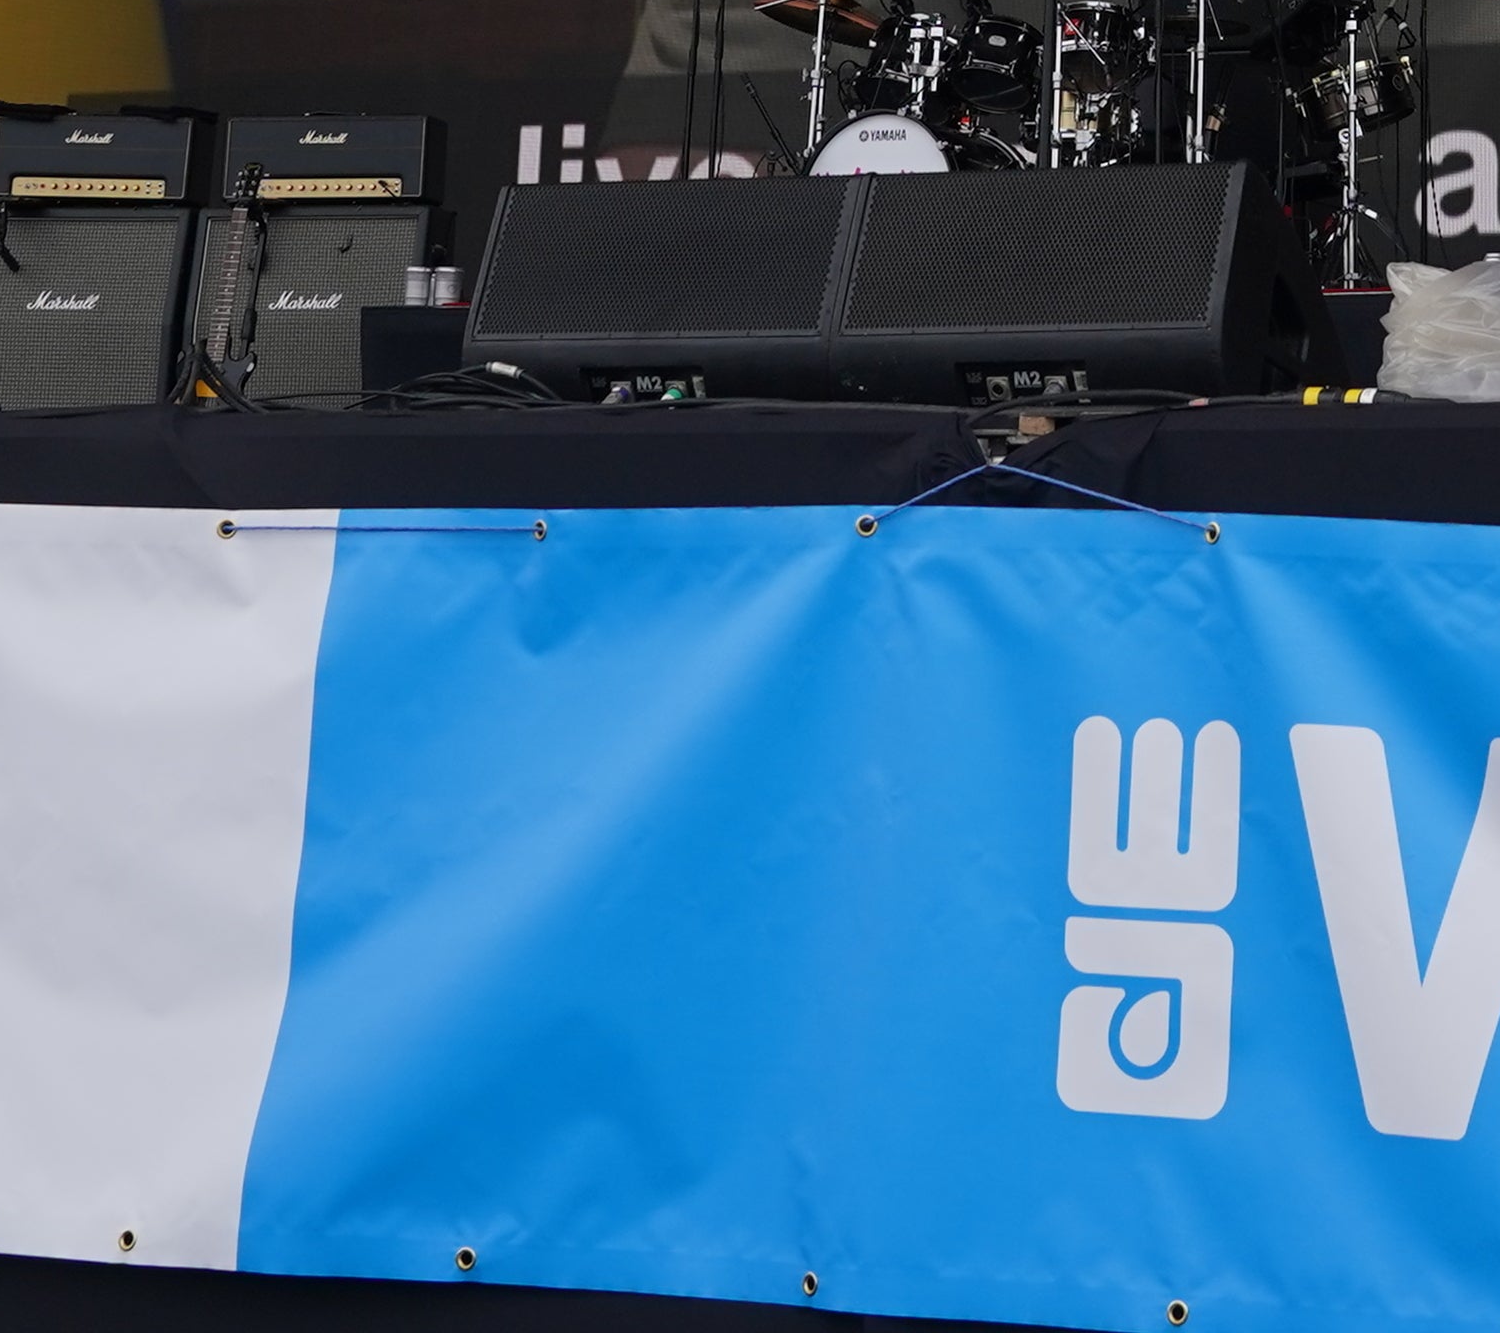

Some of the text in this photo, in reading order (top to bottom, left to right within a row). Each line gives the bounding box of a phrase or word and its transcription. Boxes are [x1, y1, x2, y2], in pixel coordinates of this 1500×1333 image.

[65, 129, 115, 146] Marshall
[299, 129, 348, 146] Marshall
[870, 129, 907, 141] YAMAHA
[27, 289, 99, 311] Marshall
[268, 289, 343, 311] Marshall
[635, 375, 664, 393] M2
[1012, 370, 1043, 389] M2
